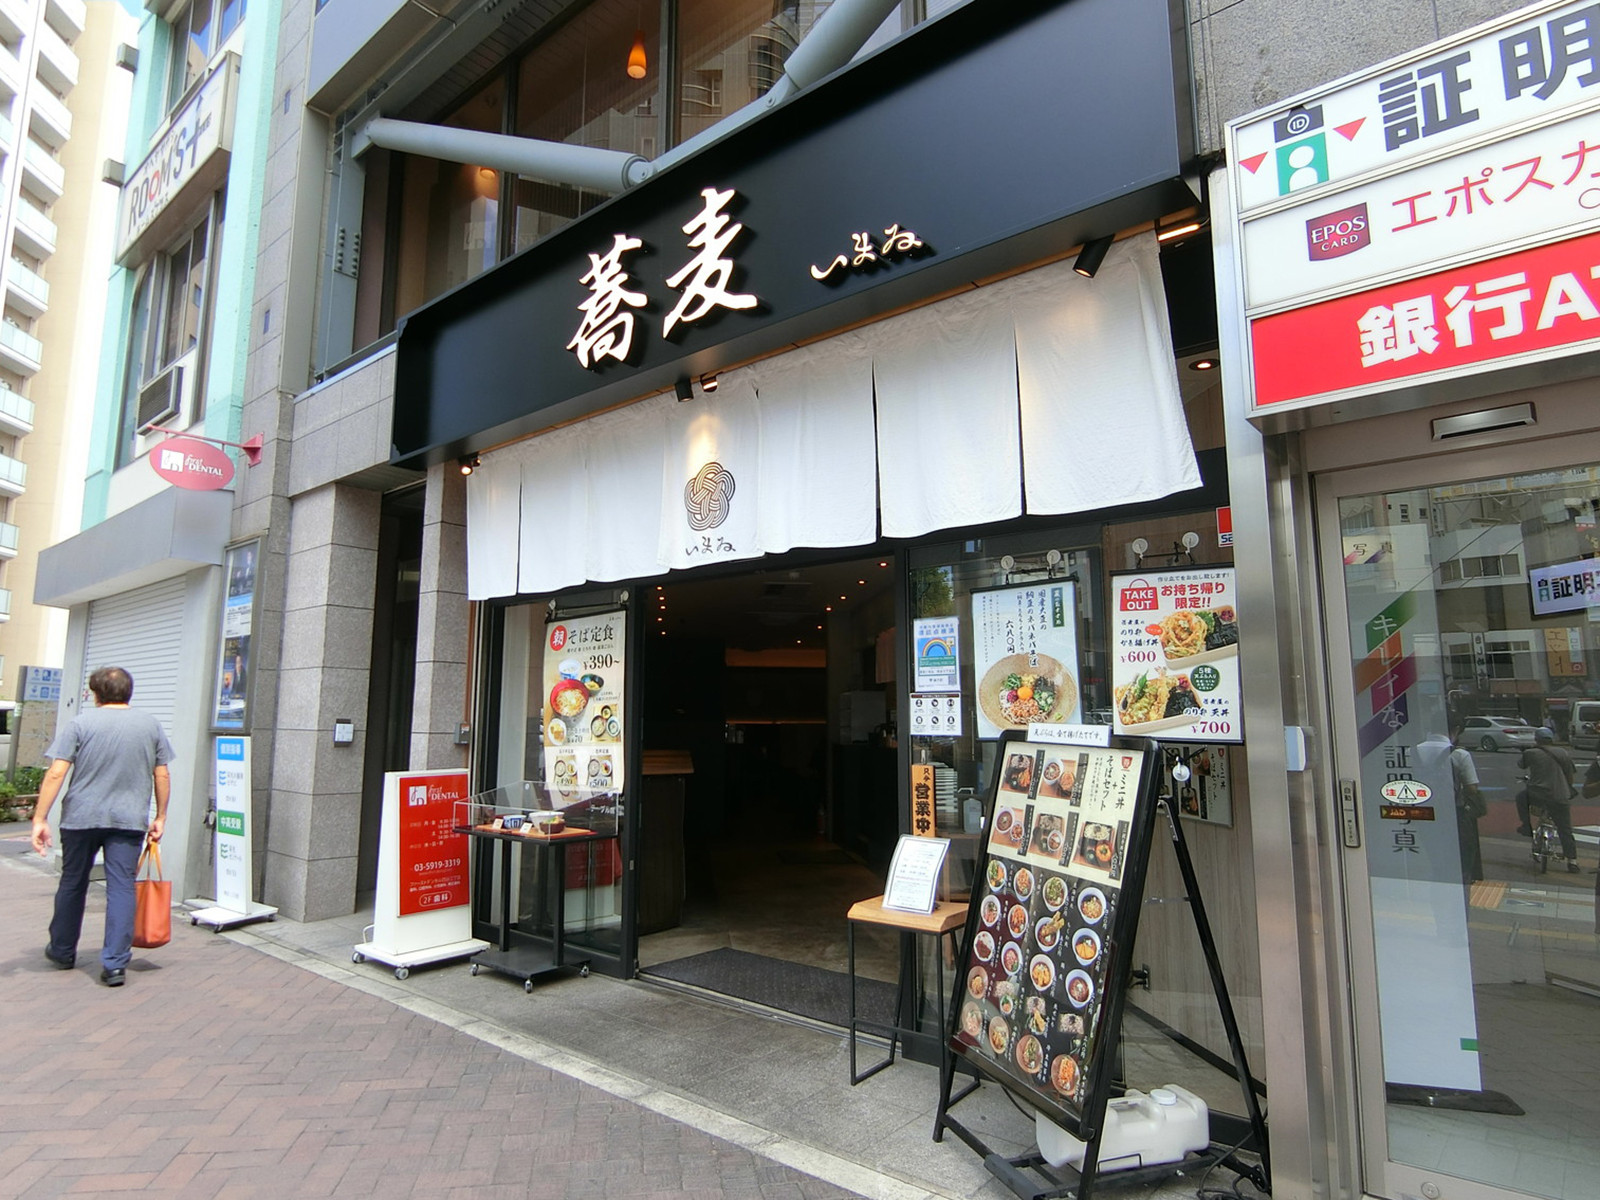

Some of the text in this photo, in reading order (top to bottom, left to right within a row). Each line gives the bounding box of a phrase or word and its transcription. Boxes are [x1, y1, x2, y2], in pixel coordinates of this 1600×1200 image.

[1311, 214, 1366, 244] EPOS
[1321, 233, 1359, 252] CARD
[566, 187, 758, 369] 蕎麦
[189, 463, 223, 476] DENTAL
[1124, 590, 1154, 600] TAKE
[1161, 582, 1226, 596] お持ち帰り
[1127, 600, 1152, 610] OUT
[1175, 597, 1211, 609] 限定!!
[568, 624, 614, 644] そば定食
[1121, 651, 1156, 663] ¥600
[1191, 721, 1231, 734] ¥700
[431, 790, 459, 800] DENTAL
[914, 782, 932, 834] 営業中
[413, 858, 461, 872] 03-5919-3319
